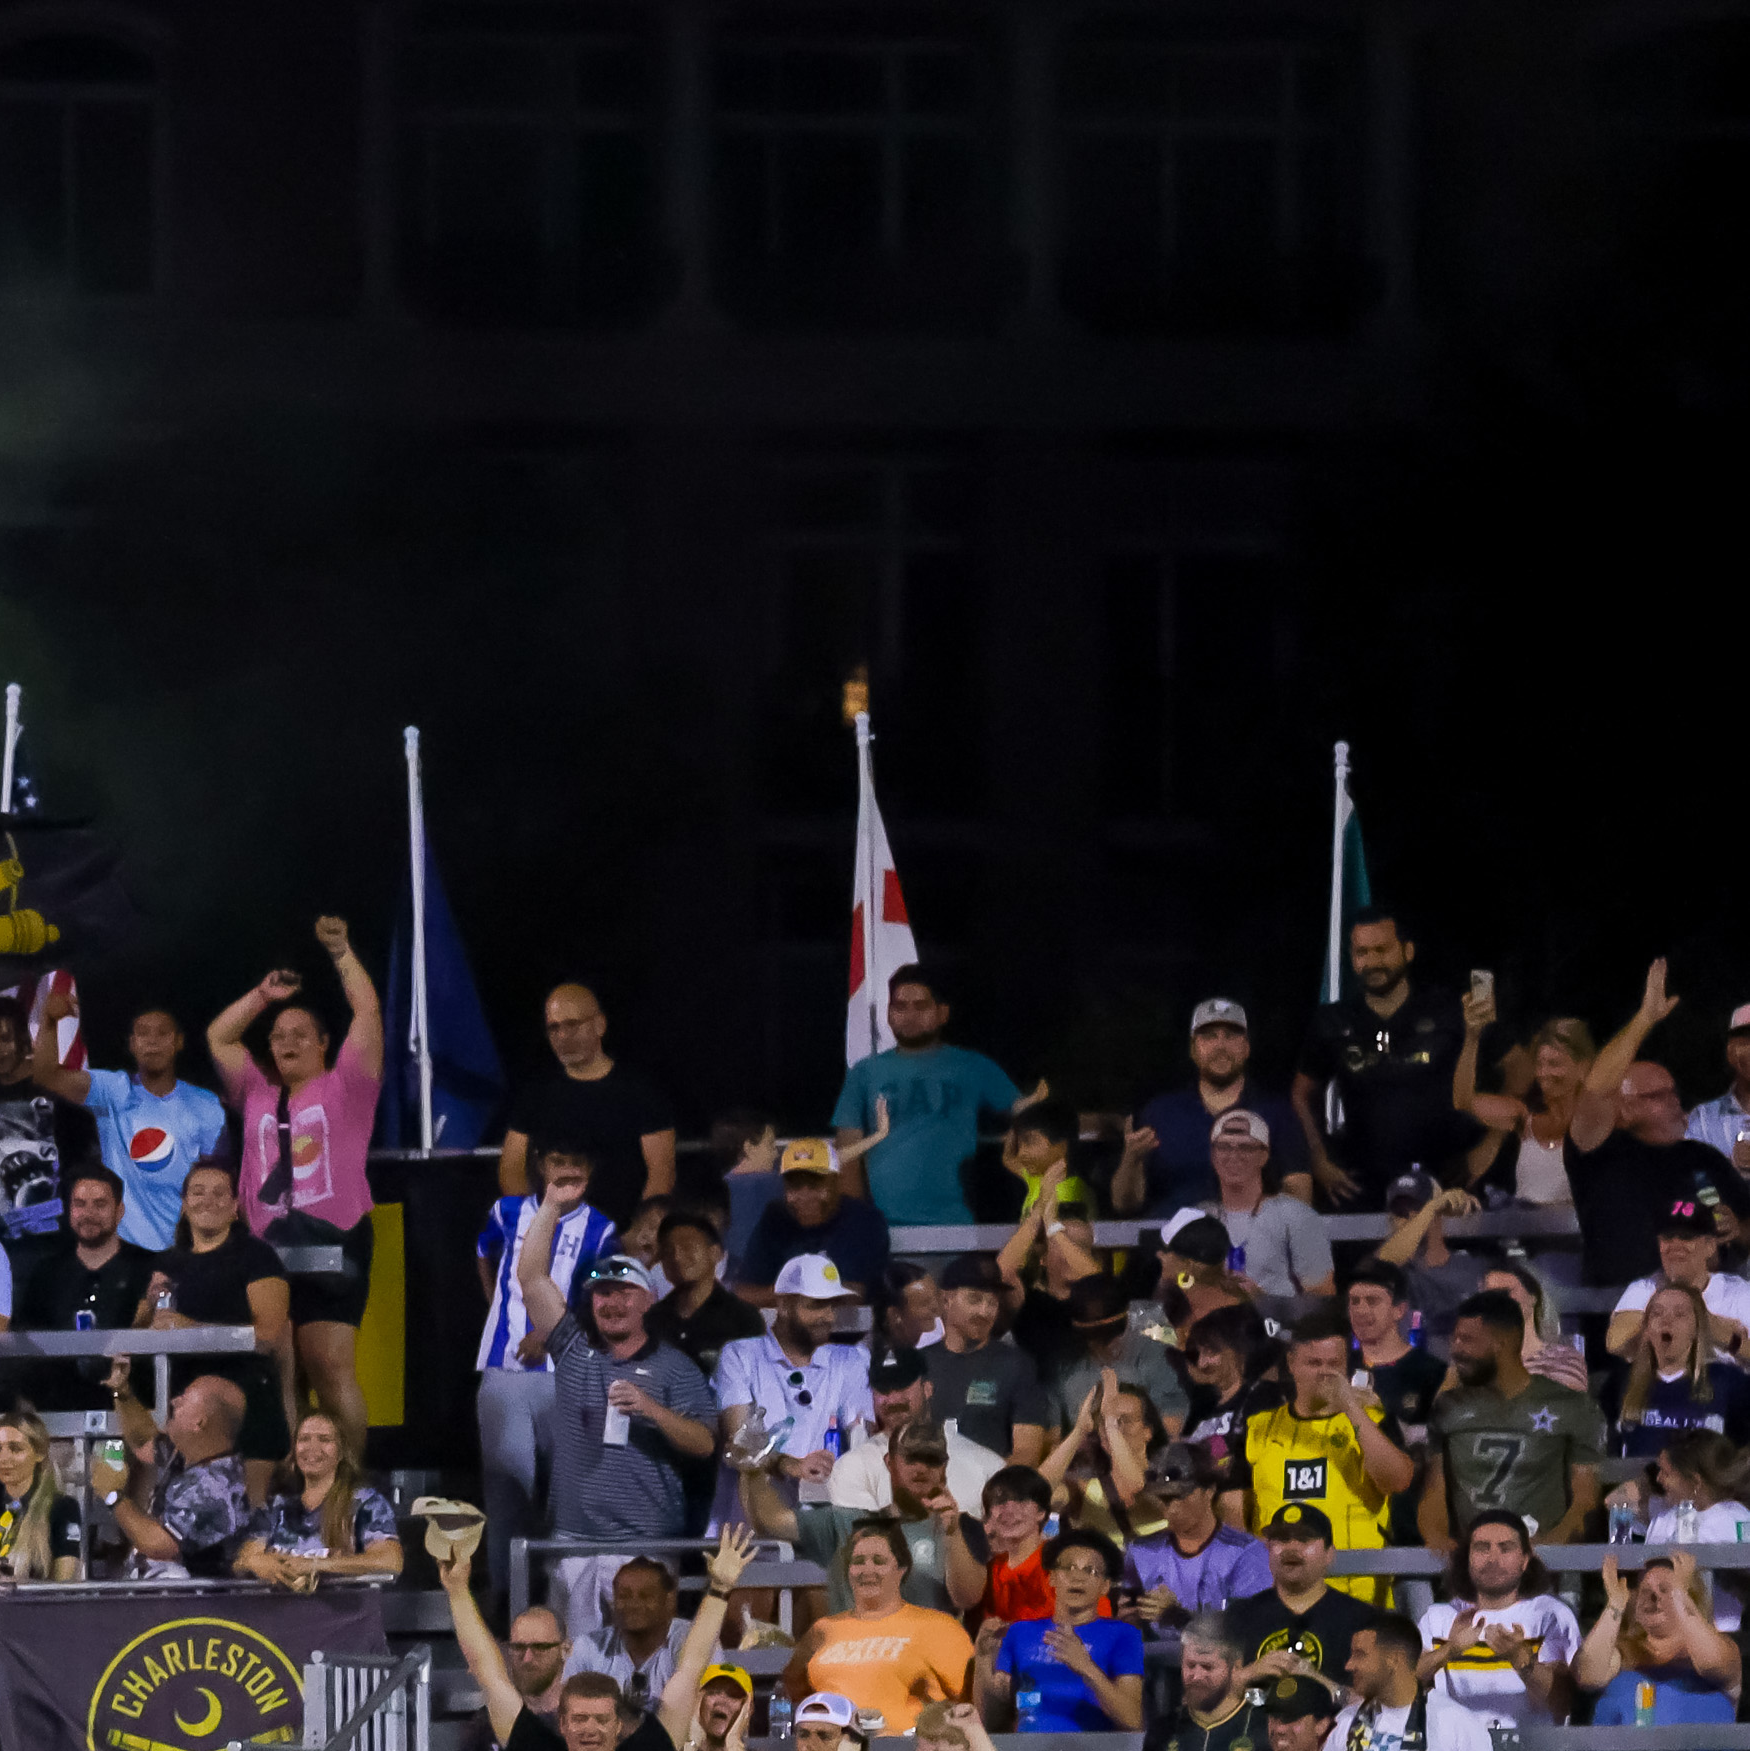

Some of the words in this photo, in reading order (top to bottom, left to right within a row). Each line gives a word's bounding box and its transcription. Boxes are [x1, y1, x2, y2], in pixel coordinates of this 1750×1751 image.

[1287, 1465, 1323, 1491] 1&1
[1471, 1432, 1527, 1511] 7
[112, 1638, 290, 1718] CHARLESTON
